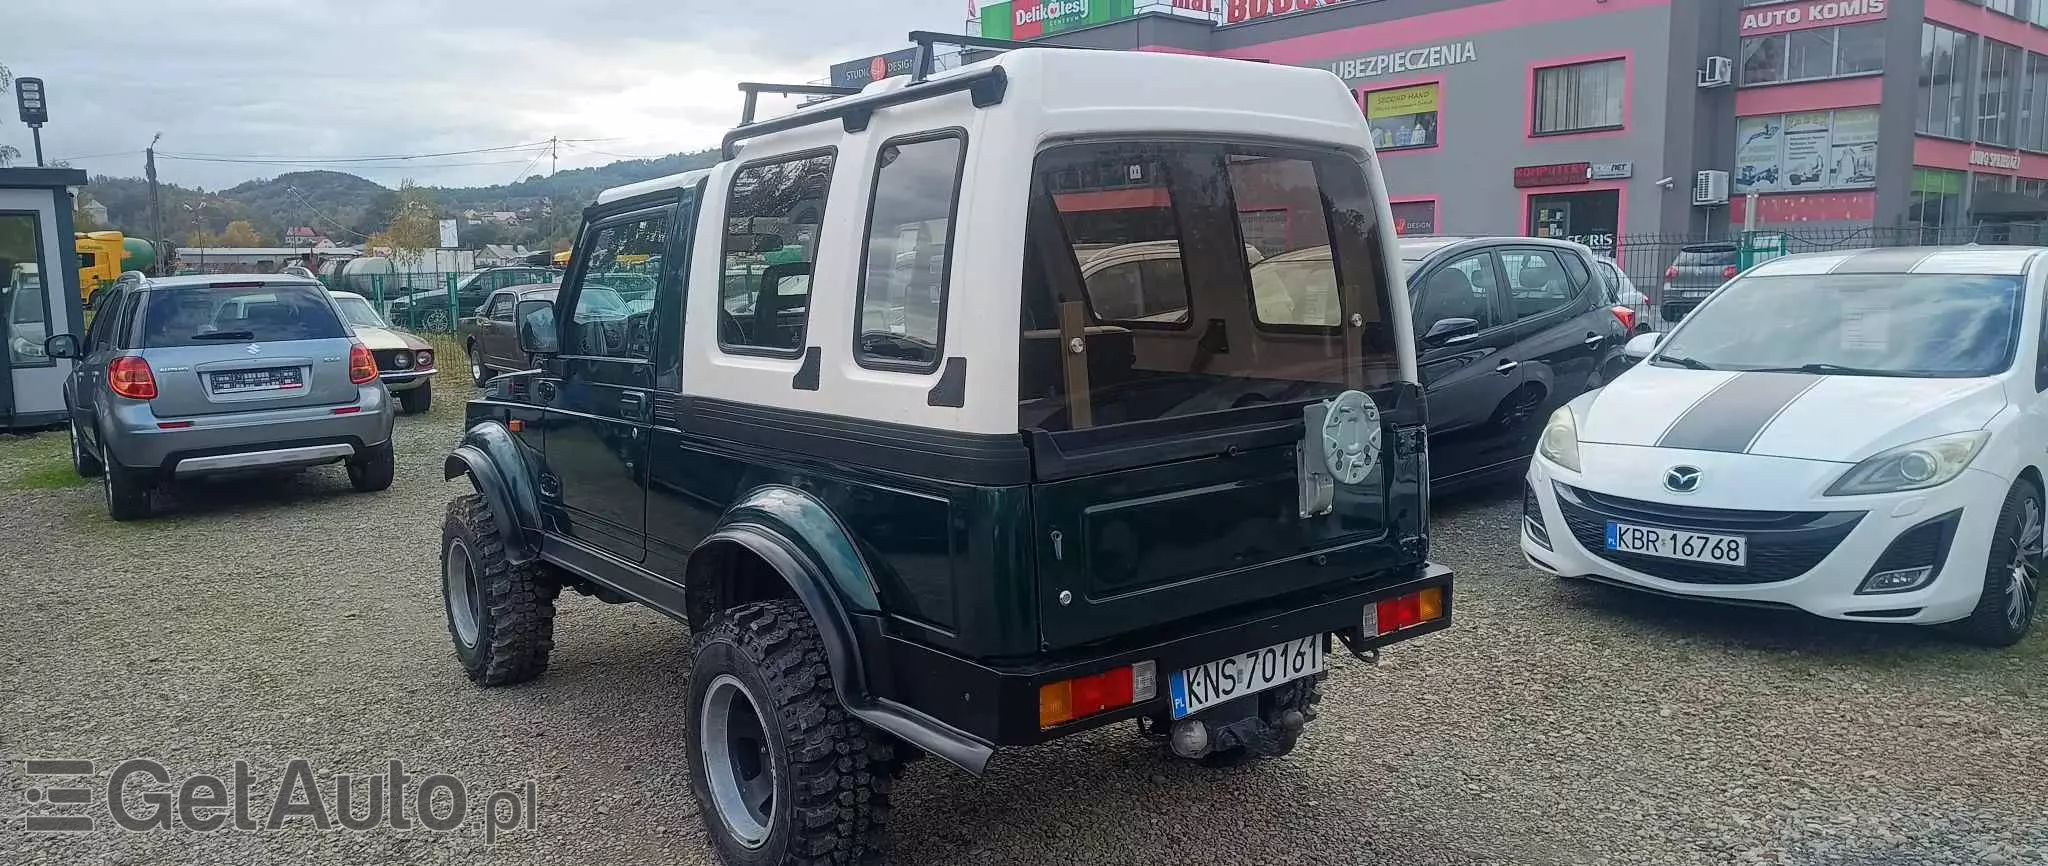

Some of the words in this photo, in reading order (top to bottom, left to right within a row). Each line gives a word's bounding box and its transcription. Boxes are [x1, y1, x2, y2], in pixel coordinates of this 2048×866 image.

[1016, 0, 1089, 26] Delikatesy
[1743, 8, 1801, 29] AUTO
[1808, 0, 1885, 21] KOMIS
[1331, 40, 1477, 80] UBEZPIECZENIA
[1619, 526, 1660, 553] KBR
[1670, 533, 1740, 561] 16768
[1175, 698, 1185, 709] PL
[1187, 658, 1237, 708] KNS
[1247, 632, 1317, 689] 70161
